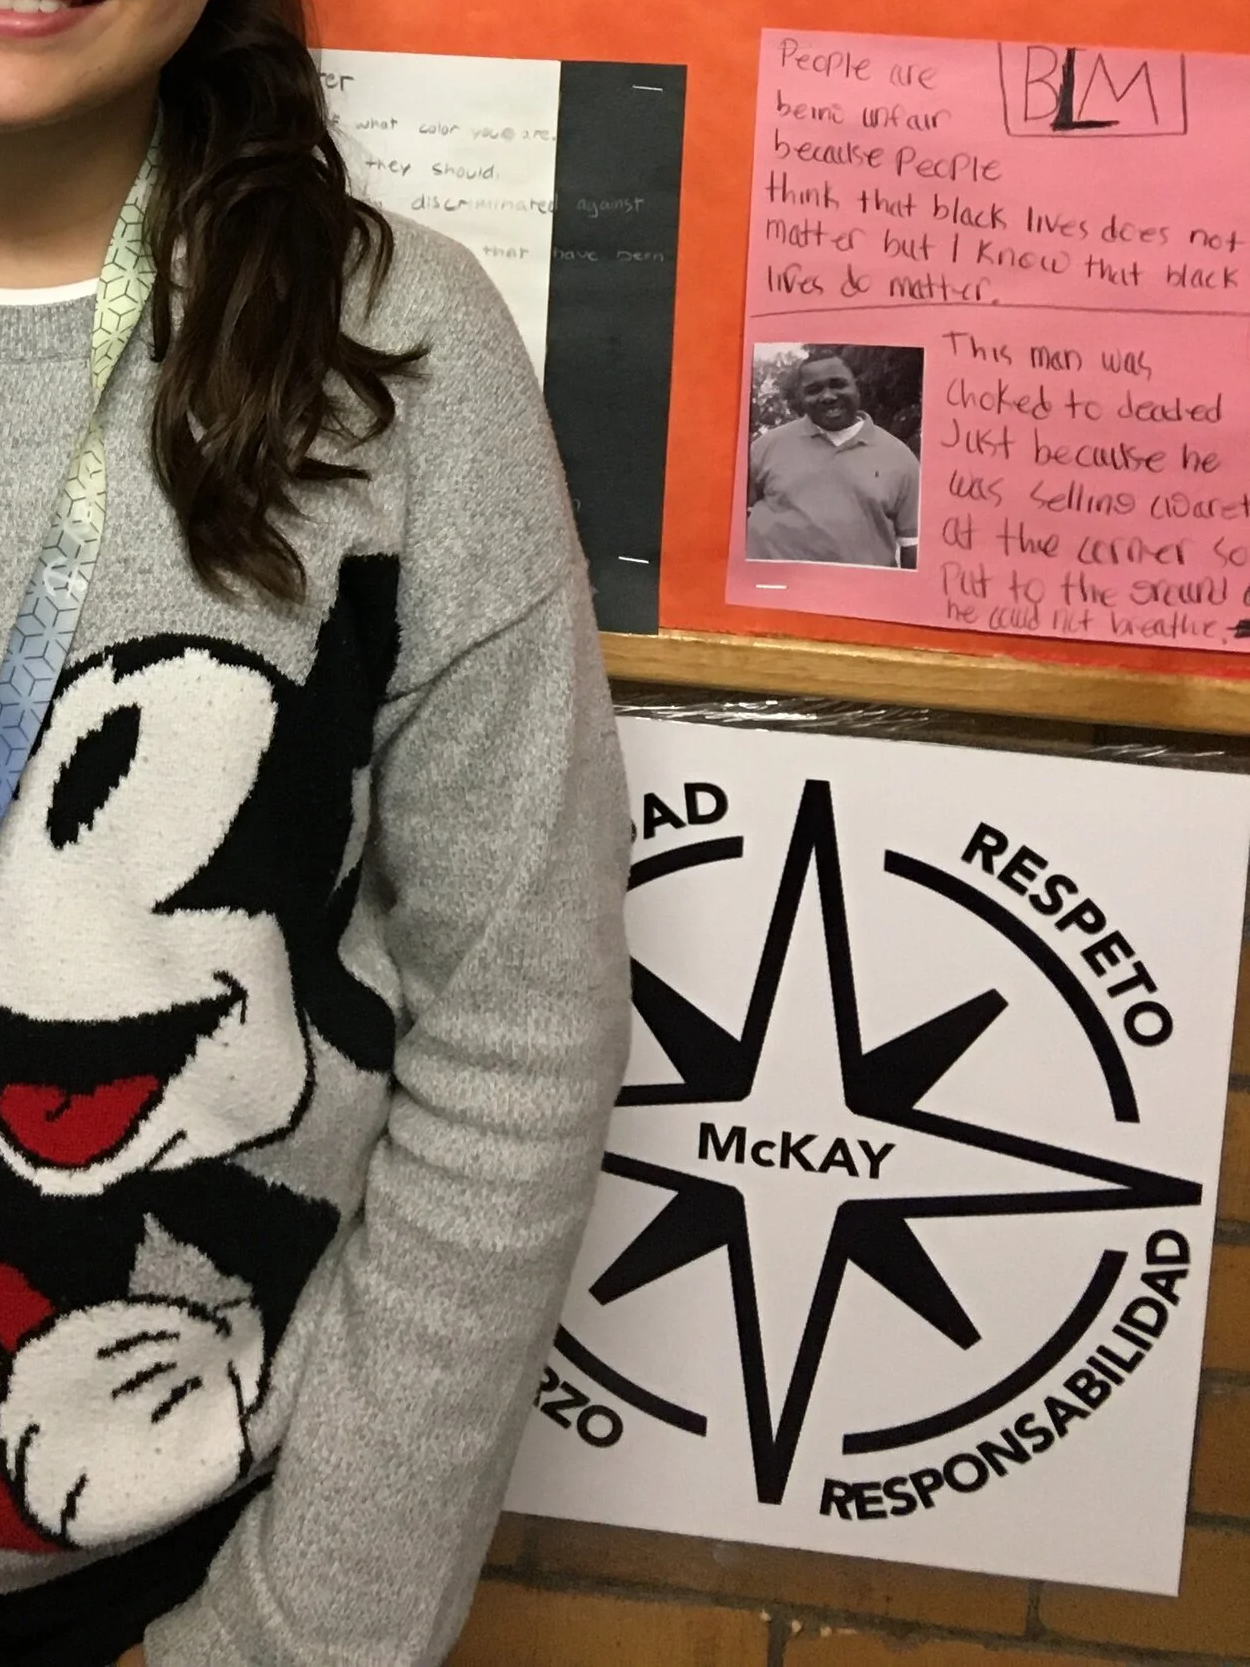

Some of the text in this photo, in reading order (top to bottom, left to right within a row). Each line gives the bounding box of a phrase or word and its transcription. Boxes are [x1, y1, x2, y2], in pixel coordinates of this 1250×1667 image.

[890, 61, 938, 91] are
[1023, 44, 1159, 132] BLM
[355, 116, 399, 131] what
[418, 120, 461, 137] color
[861, 104, 951, 131] unfair
[364, 156, 412, 178] they
[774, 129, 883, 170] because
[576, 197, 646, 219] against
[765, 170, 1248, 253] think that black lives does not
[765, 215, 857, 250] matter
[883, 228, 935, 264] but
[1084, 252, 1145, 288] that
[1166, 258, 1240, 291] black
[839, 268, 871, 296] do
[942, 330, 1152, 382] This man was
[1065, 387, 1102, 420] to
[1033, 427, 1166, 474] because
[1182, 443, 1222, 474] he
[949, 469, 1005, 508] was
[996, 517, 1061, 559] the
[1007, 569, 1046, 605] to
[1059, 570, 1120, 608] the
[947, 599, 980, 626] he
[988, 604, 1040, 633] could
[1052, 607, 1094, 634] not
[630, 781, 729, 847] AD
[960, 821, 1175, 1049] RESPETO
[696, 1121, 898, 1180] McKAY
[818, 1226, 1192, 1523] RESPONSABILIDAD
